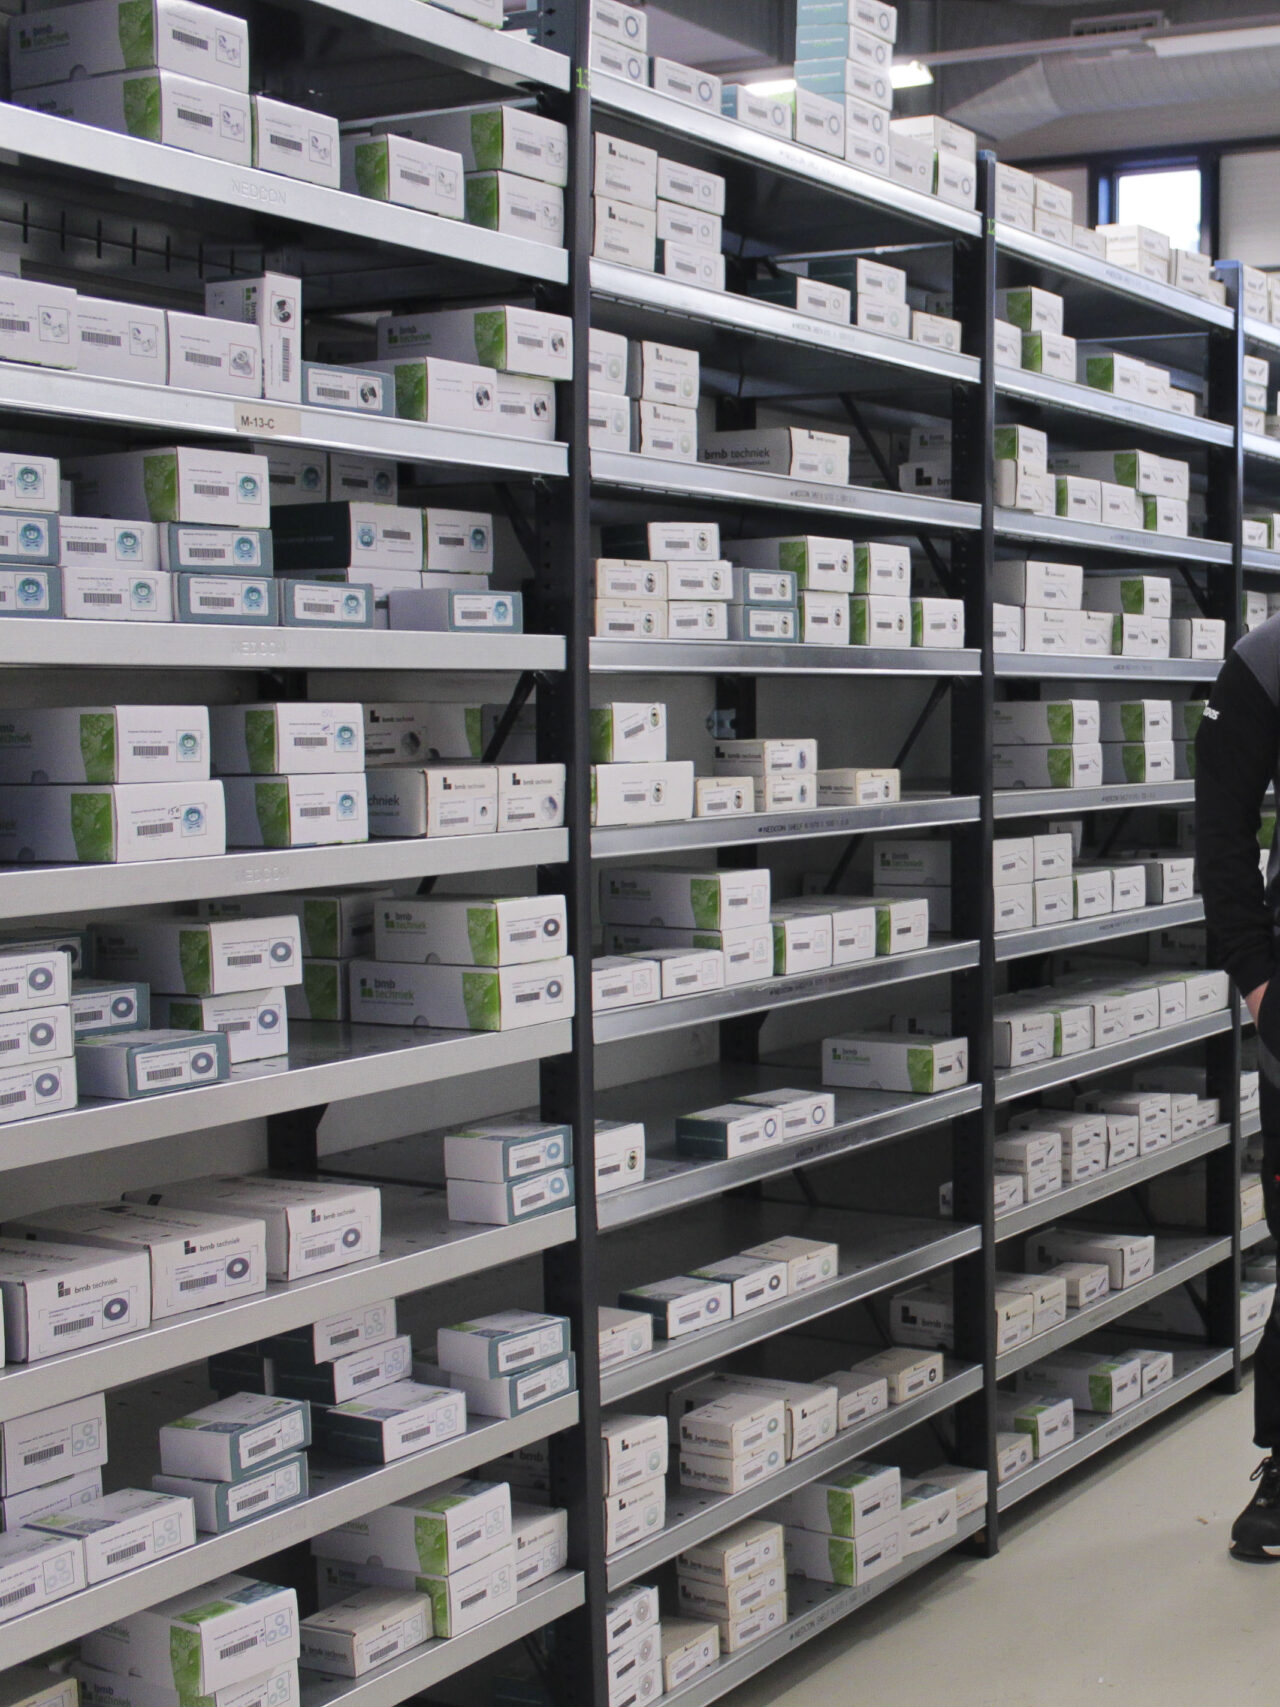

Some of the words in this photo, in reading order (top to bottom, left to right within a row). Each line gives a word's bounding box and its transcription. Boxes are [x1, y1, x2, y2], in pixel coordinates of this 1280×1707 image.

[240, 415, 275, 430] M-13-C
[704, 448, 728, 460] bmb
[730, 447, 770, 459] techniek
[368, 794, 400, 806] chniek
[395, 912, 412, 921] bmb
[395, 920, 426, 929] techniek
[374, 978, 396, 988] bmb
[375, 989, 415, 1000] techniek
[200, 1243, 215, 1252] bmb
[217, 1237, 241, 1249] techniek
[74, 1284, 92, 1293] bmb
[93, 1277, 118, 1290] techniek
